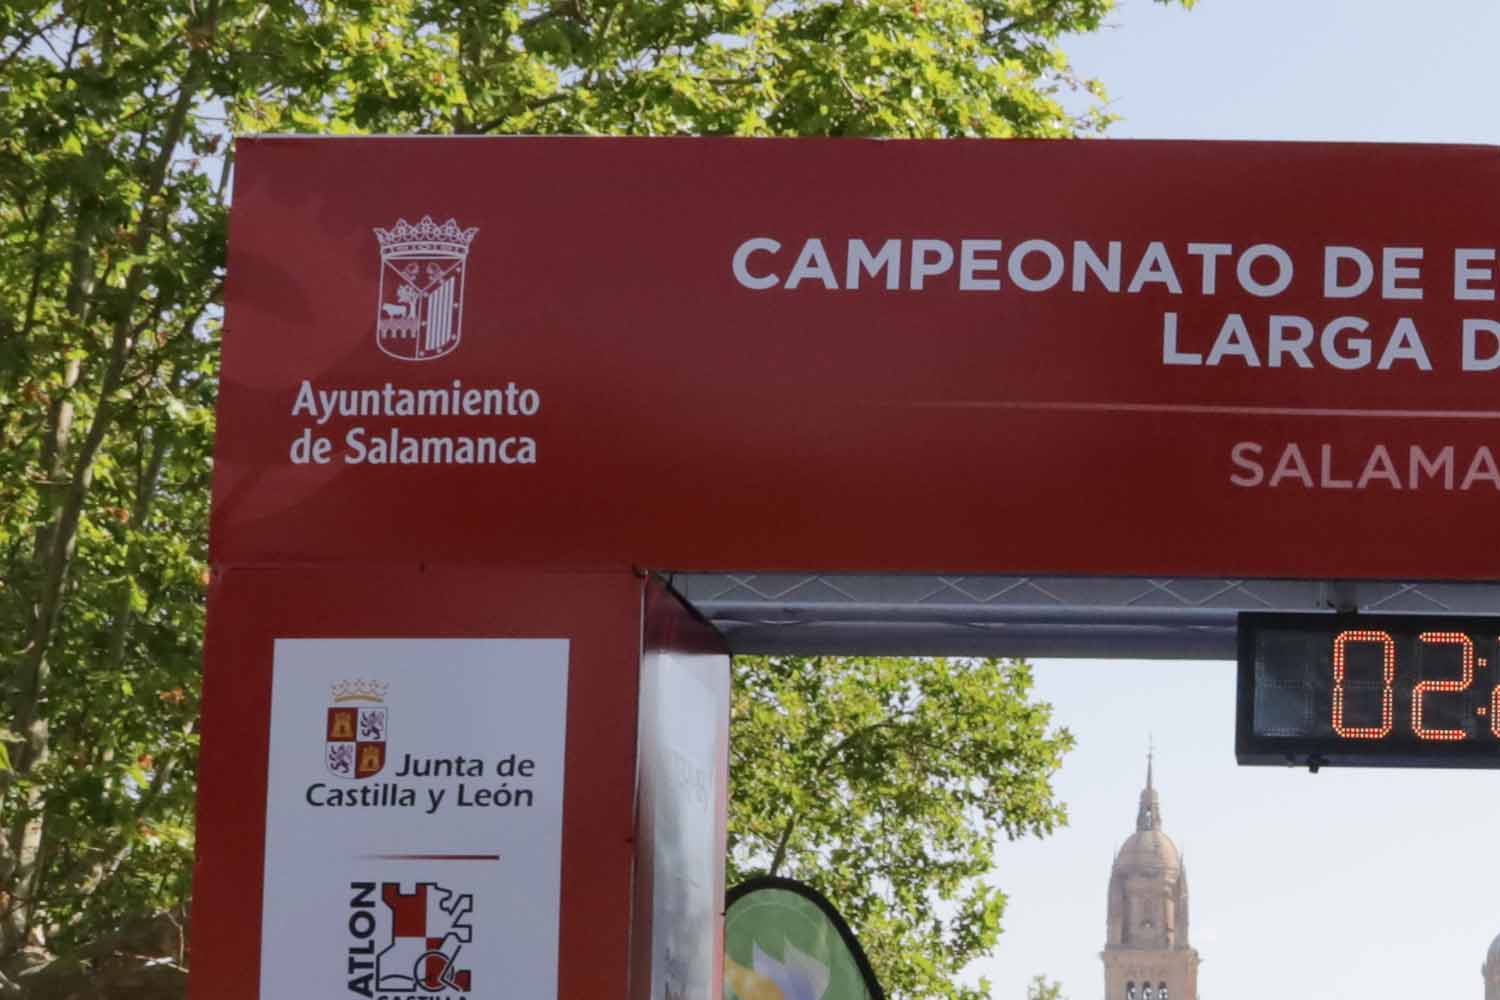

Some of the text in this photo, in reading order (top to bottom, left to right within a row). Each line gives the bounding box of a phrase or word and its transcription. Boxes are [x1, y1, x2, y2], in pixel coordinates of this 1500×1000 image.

[732, 236, 1293, 297] CAMPEONATO
[1324, 246, 1424, 300] DE
[1163, 311, 1432, 371] LARGA
[291, 380, 541, 424] Ayuntamiento
[290, 427, 537, 465] de Salamanca
[395, 753, 535, 778] Junta de
[305, 781, 534, 813] Castilla y León
